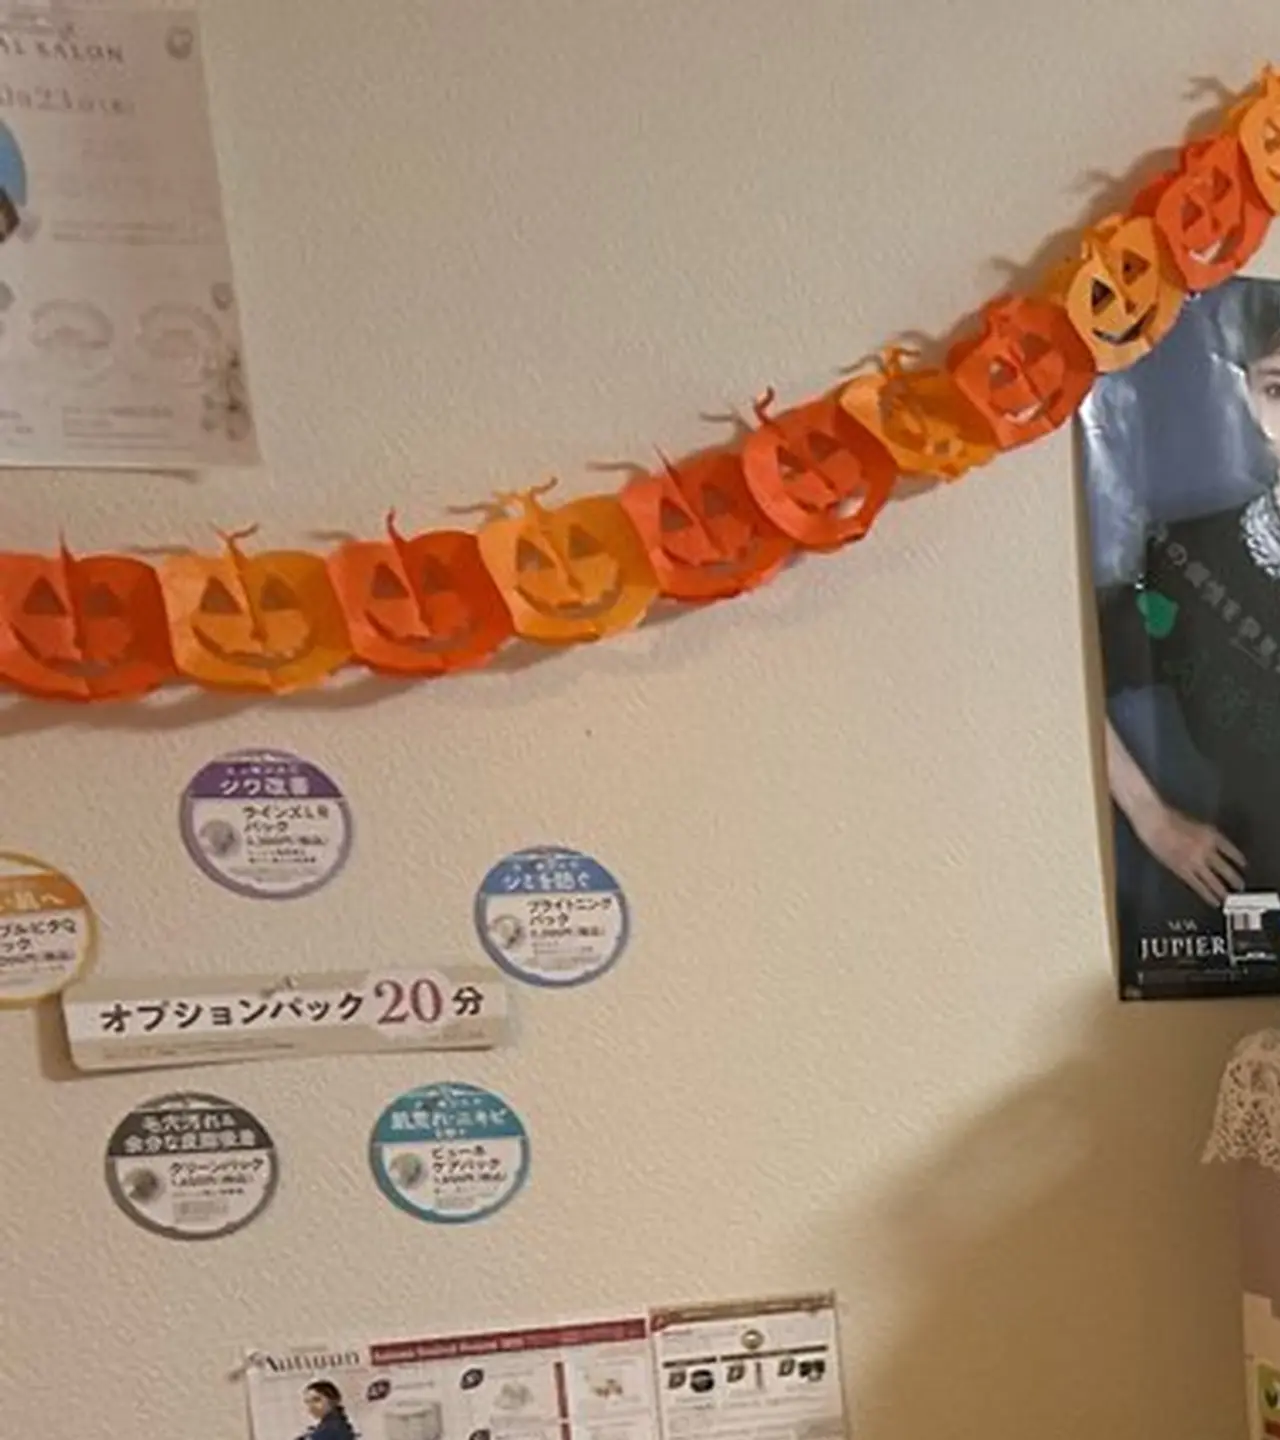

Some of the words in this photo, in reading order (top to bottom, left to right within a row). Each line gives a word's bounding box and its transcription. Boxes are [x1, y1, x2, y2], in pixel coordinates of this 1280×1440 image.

[1140, 935, 1227, 960] JUPIER
[100, 978, 484, 1033] オプションパック20分
